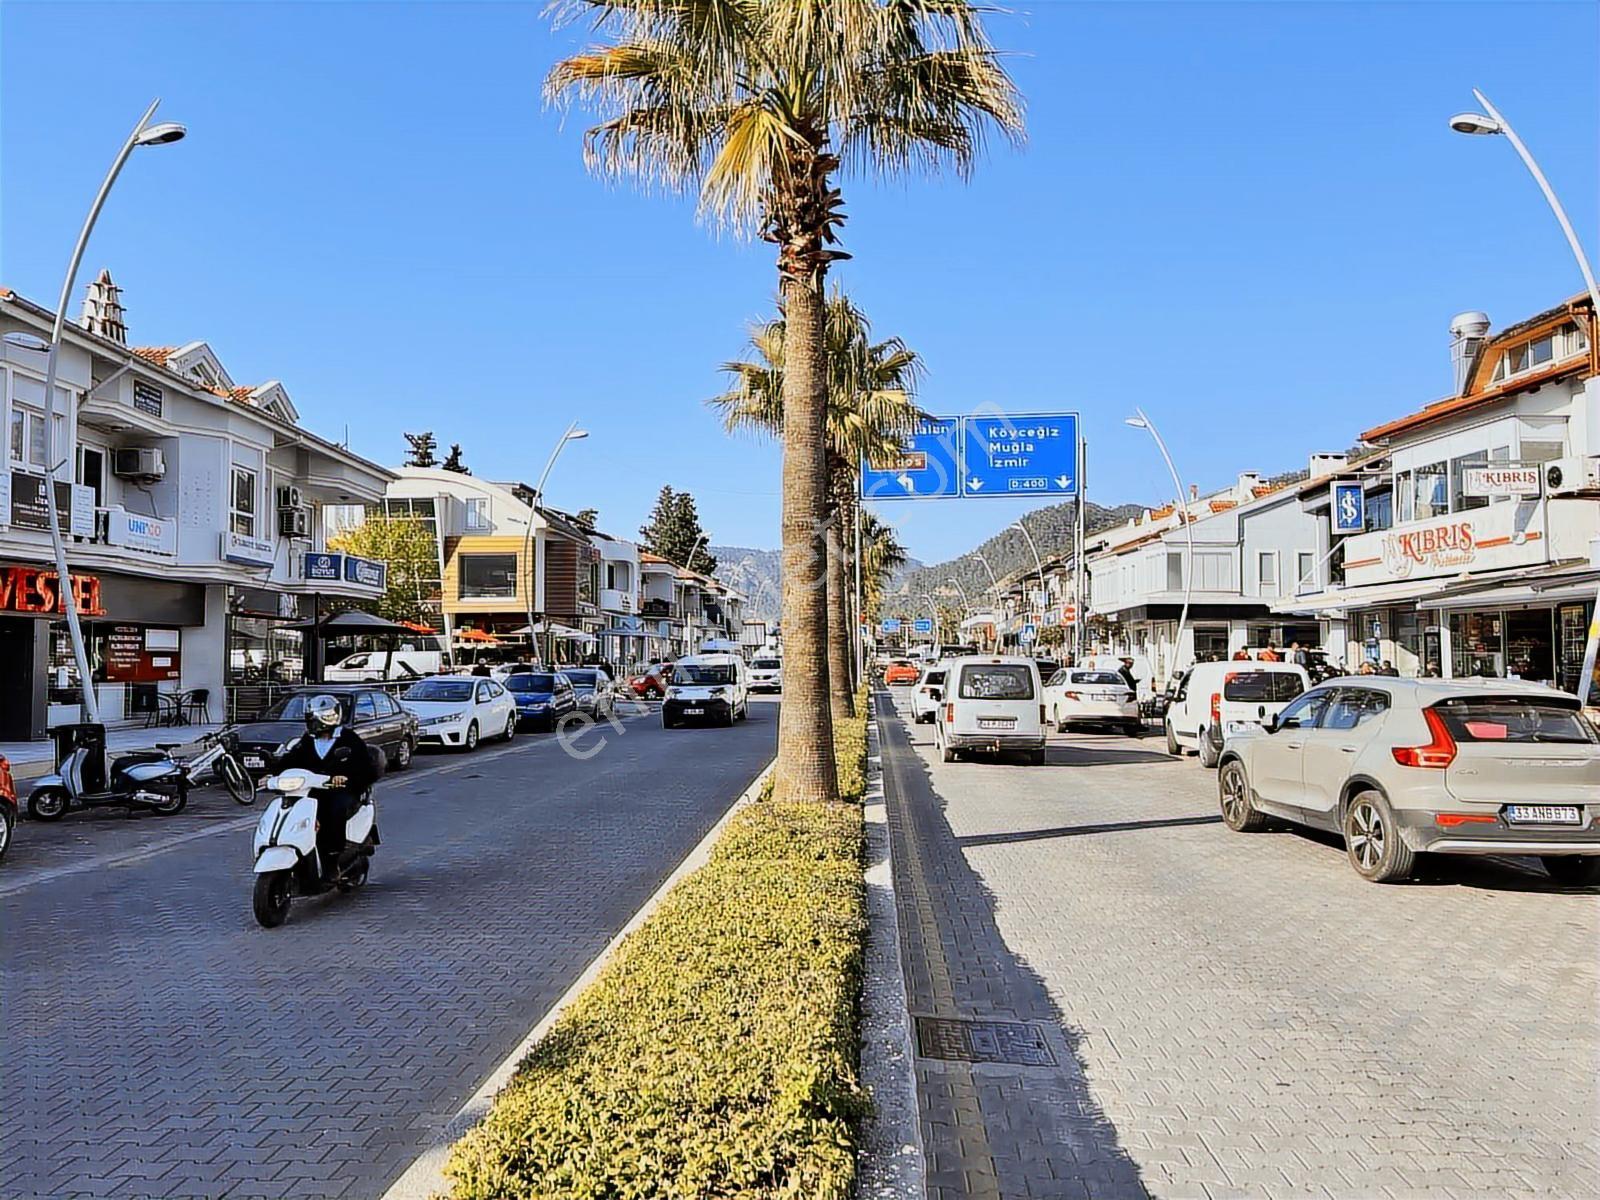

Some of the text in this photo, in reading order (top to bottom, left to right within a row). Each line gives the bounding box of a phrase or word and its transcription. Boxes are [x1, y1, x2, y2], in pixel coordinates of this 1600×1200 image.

[988, 426, 1060, 440] Köyceğiz
[988, 441, 1034, 454] Muğla
[1483, 471, 1537, 487] KIBRIS
[1399, 522, 1472, 563] KIBRIS
[1515, 807, 1530, 819] 33
